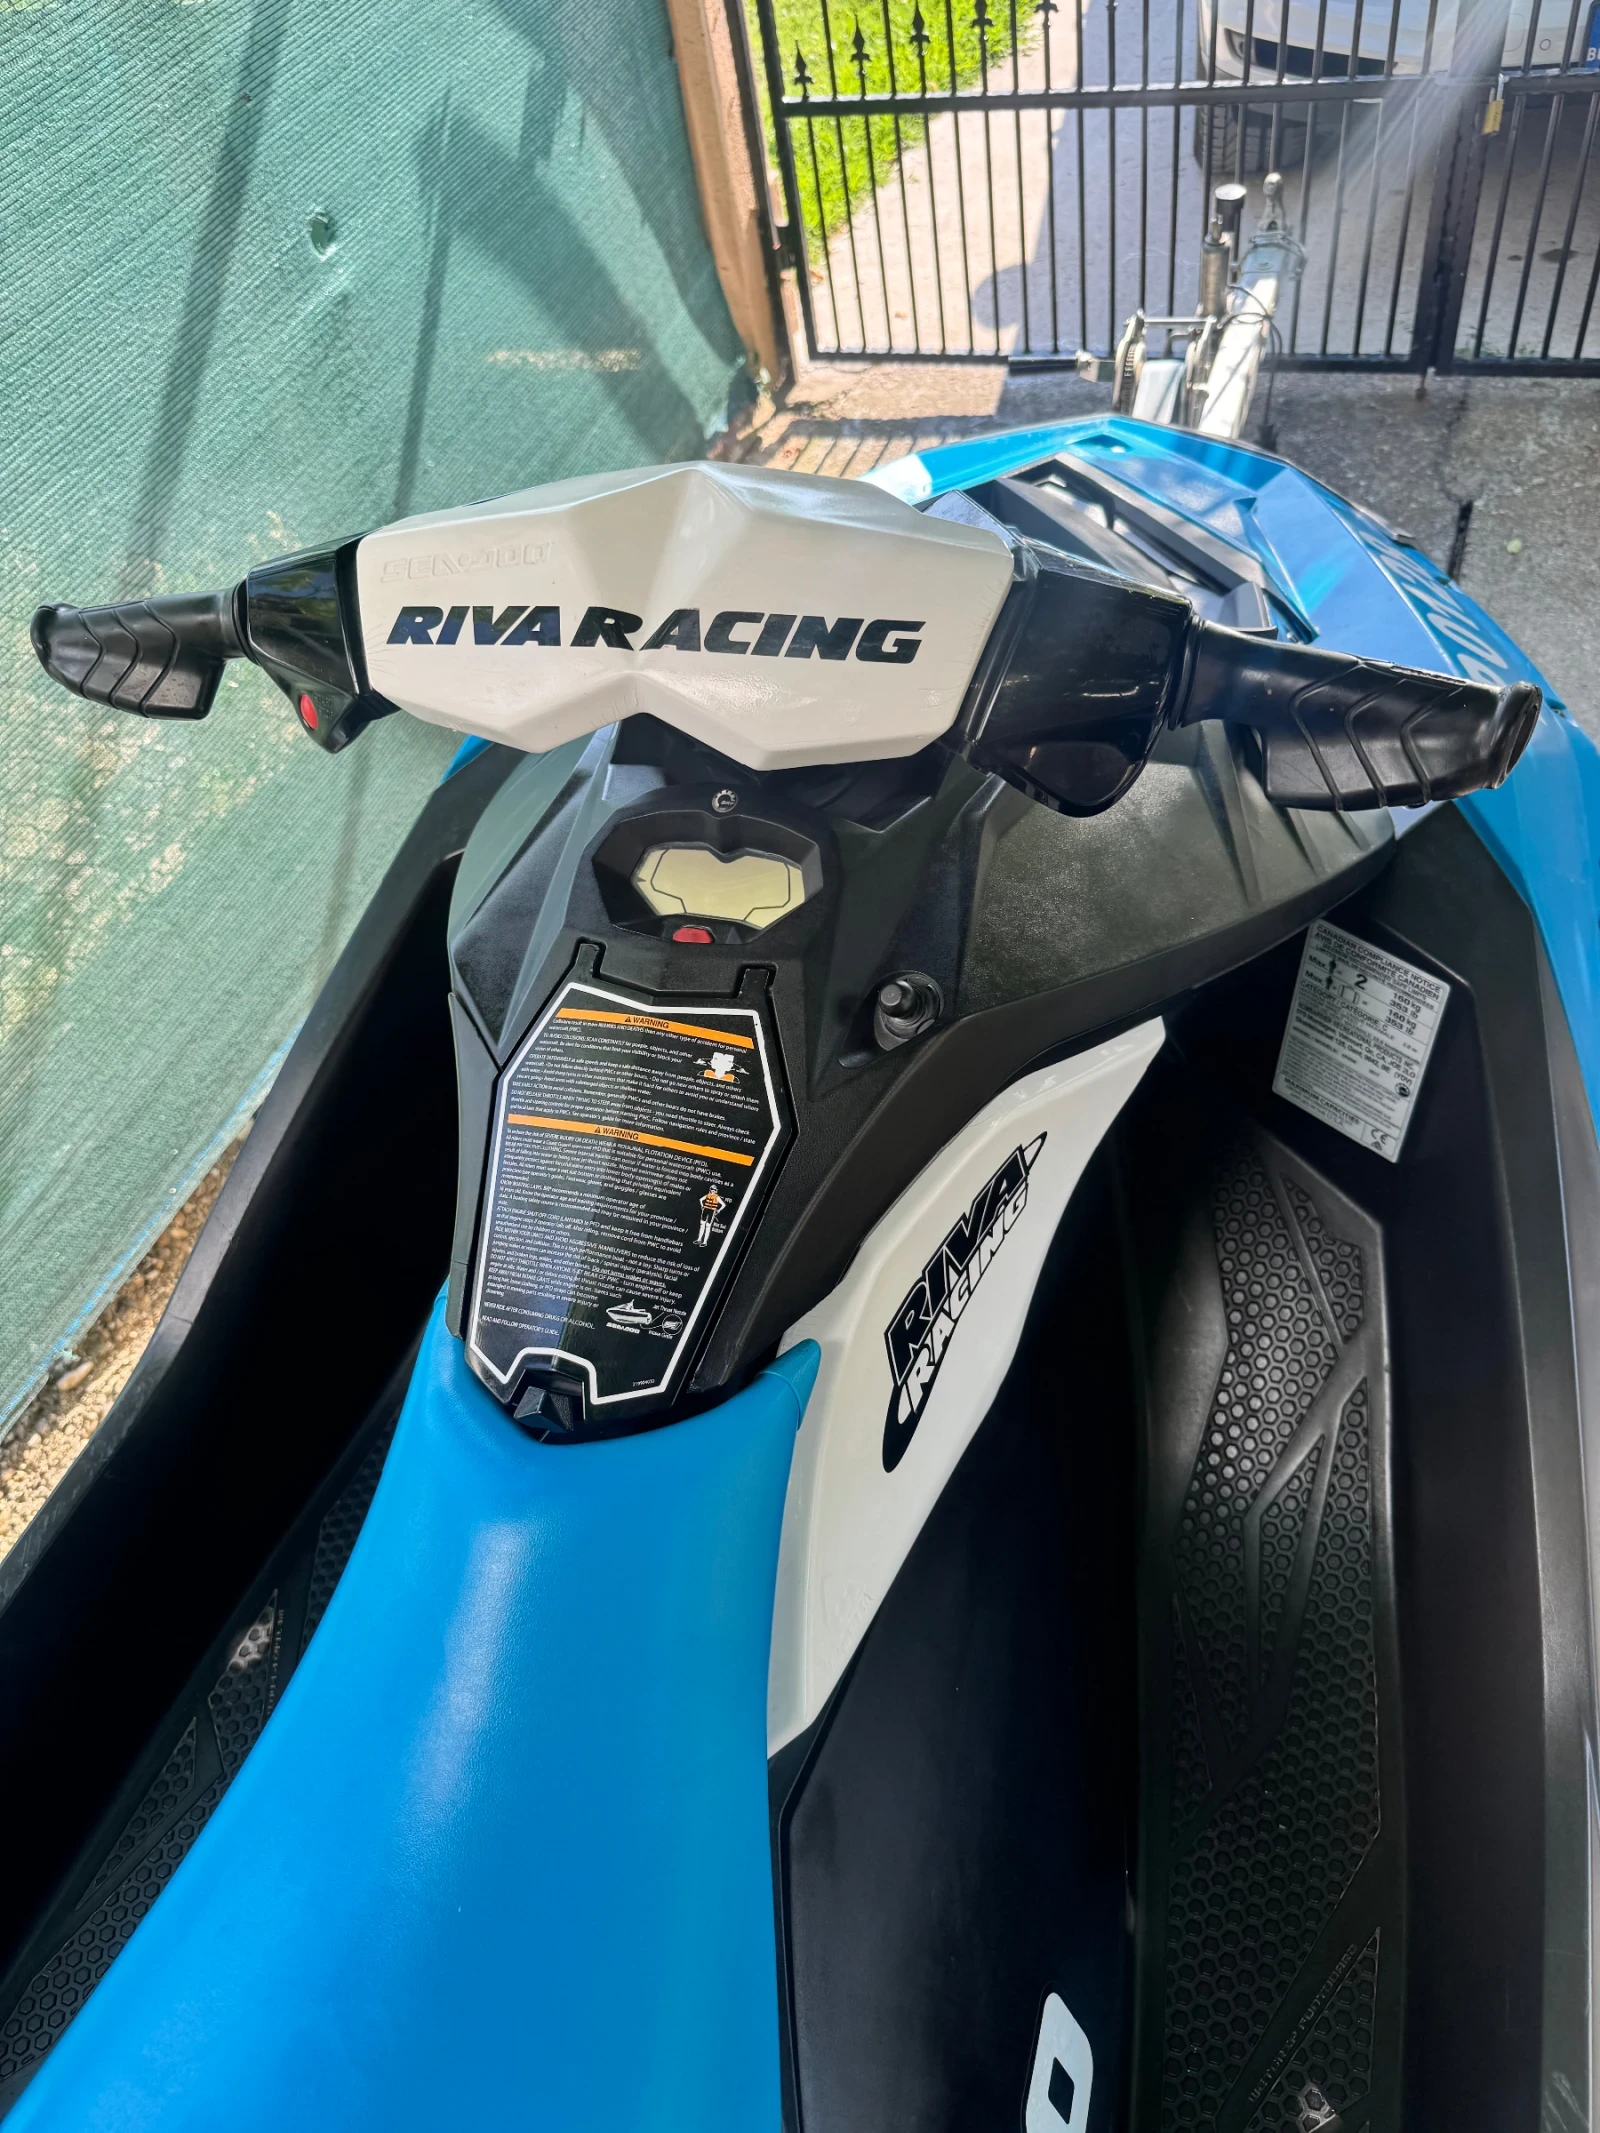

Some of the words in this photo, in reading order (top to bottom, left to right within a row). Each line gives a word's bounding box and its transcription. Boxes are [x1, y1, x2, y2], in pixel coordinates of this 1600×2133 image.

[386, 605, 561, 647] RIVA
[570, 605, 927, 665] RACING
[1314, 930, 1334, 946] AVIS
[1332, 940, 1345, 951] DE
[1396, 973, 1439, 1000] CANADIEN
[1316, 924, 1356, 950] CANADIAN
[1357, 945, 1409, 977] COMPLIANCE
[1409, 972, 1440, 993] NOTICE
[1299, 979, 1336, 1003] CATEGORY
[1380, 1023, 1388, 1032] C
[1353, 971, 1368, 991] 2
[1389, 998, 1408, 1014] 353
[1410, 1009, 1418, 1019] lb
[1387, 1008, 1405, 1023] 160
[1404, 1017, 1417, 1030] kg
[1392, 991, 1410, 1006] 160
[1409, 1000, 1421, 1013] kg
[632, 1016, 669, 1028] WARNING
[1384, 1015, 1403, 1030] 353
[1405, 1026, 1414, 1036] lb
[602, 1126, 639, 1140] WARNING
[884, 1143, 1029, 1387] RIVA
[906, 1180, 1031, 1414] RACING
